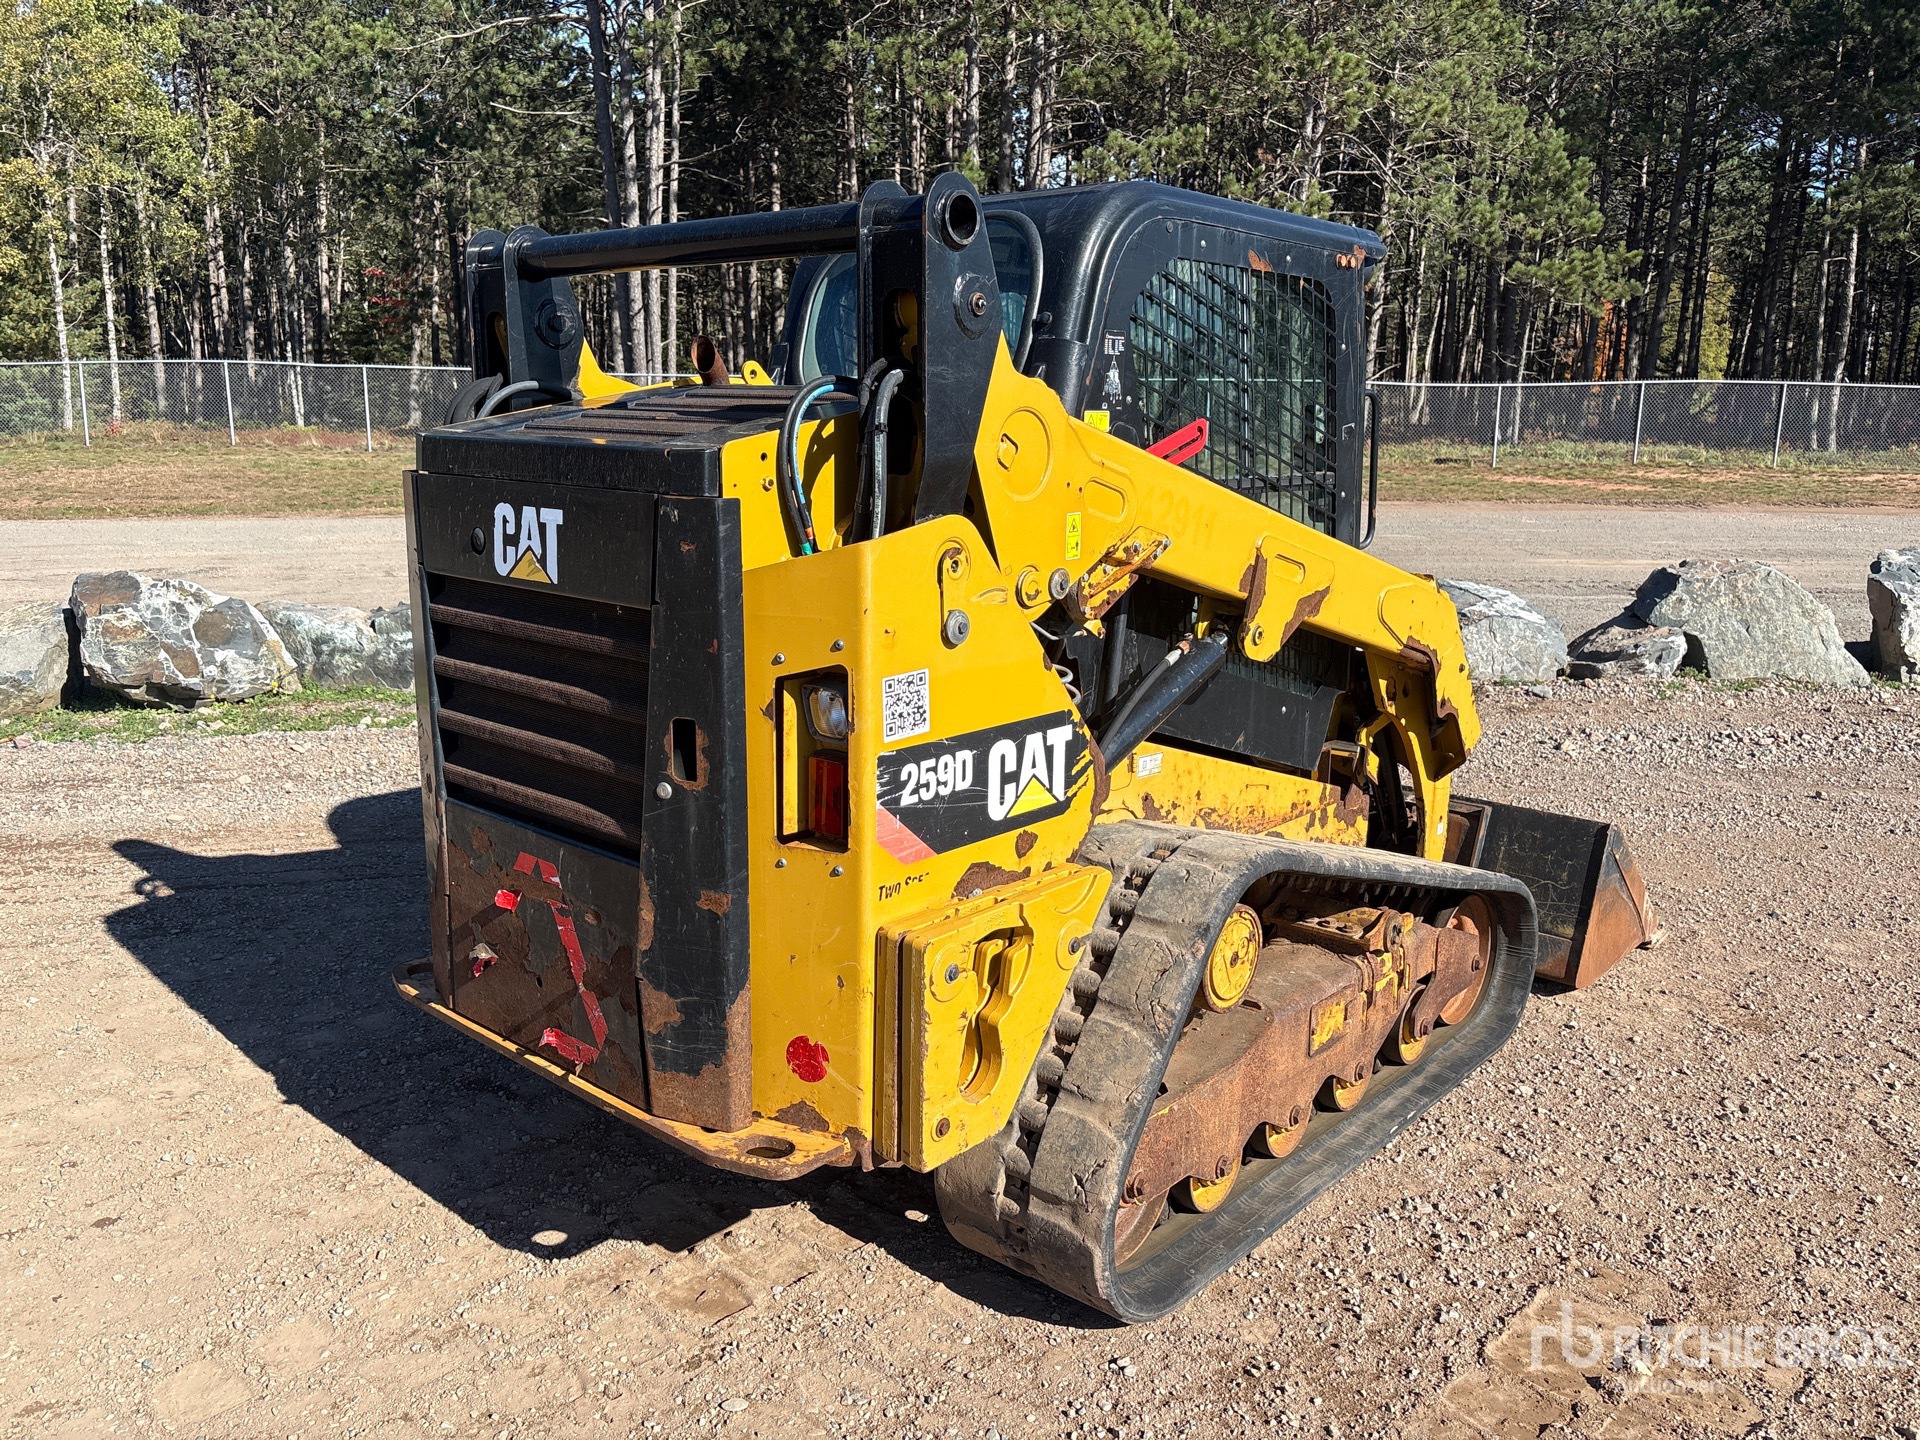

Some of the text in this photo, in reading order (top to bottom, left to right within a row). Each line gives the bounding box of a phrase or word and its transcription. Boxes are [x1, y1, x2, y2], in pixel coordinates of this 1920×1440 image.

[493, 502, 564, 585] CAT
[900, 724, 1073, 821] 259D CAT
